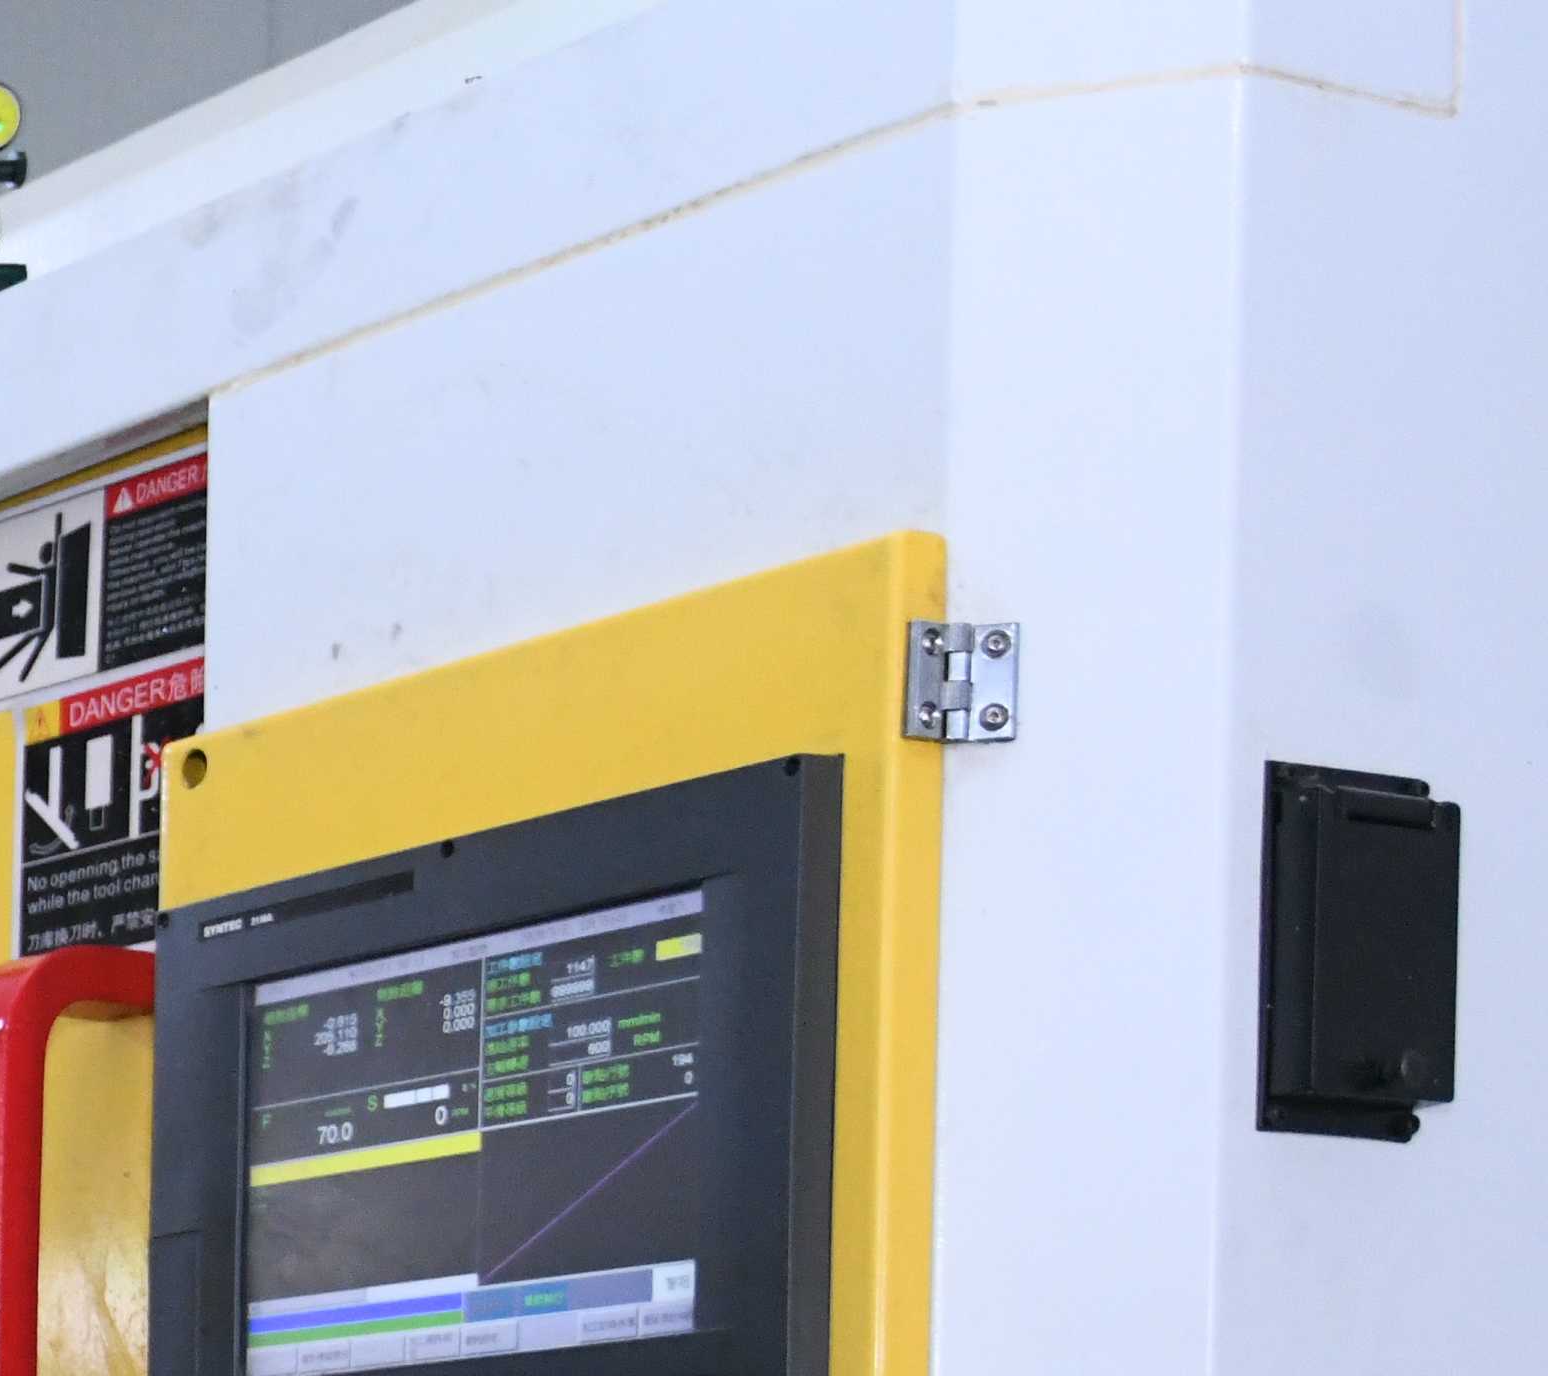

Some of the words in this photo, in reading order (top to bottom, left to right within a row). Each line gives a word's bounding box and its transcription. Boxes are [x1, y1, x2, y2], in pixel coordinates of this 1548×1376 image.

[136, 464, 200, 503] DANGER
[69, 676, 165, 729] DANGER
[27, 875, 48, 892] No
[121, 850, 146, 868] the
[27, 892, 65, 915] while
[67, 886, 92, 906] the
[94, 877, 121, 900] tool
[317, 1121, 354, 1144] 70.0
[435, 1105, 448, 1126] 0
